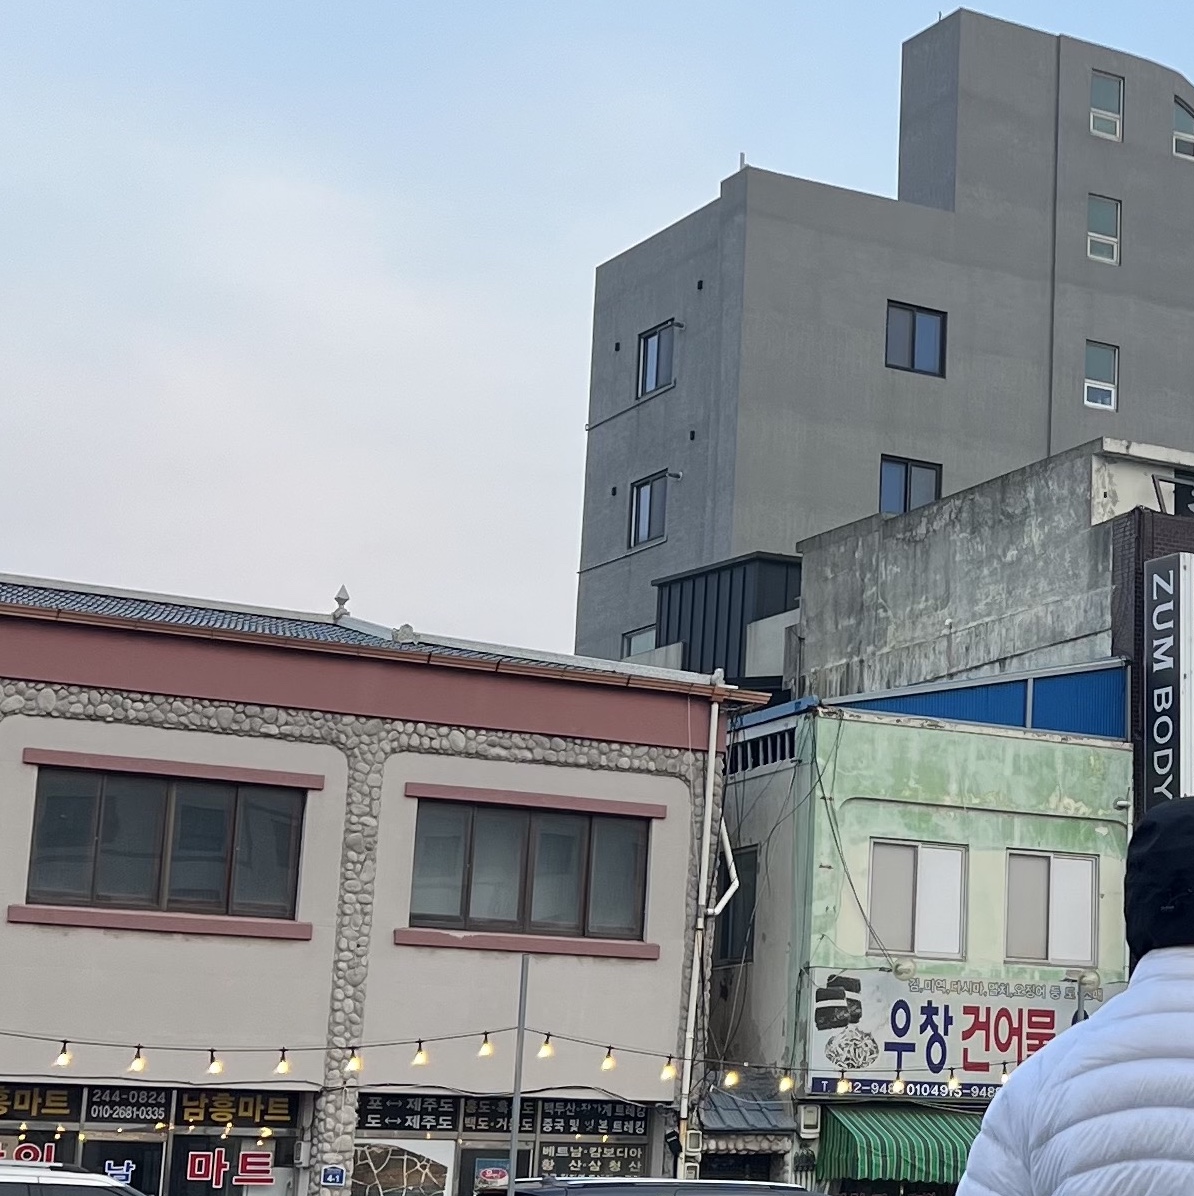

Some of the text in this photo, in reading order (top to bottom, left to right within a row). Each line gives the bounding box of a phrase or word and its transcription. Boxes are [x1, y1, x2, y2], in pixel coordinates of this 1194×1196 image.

[1152, 570, 1174, 801] ZUM BODY
[884, 999, 953, 1074] 우창
[92, 1089, 166, 1104] 244-0824
[182, 1092, 292, 1123] 남흥마트
[406, 1097, 454, 1112] 제주도
[90, 1105, 165, 1120] 010-2681-0335
[404, 1115, 453, 1129] 제주도
[612, 1120, 645, 1134] 트레킹
[187, 1147, 275, 1189] 마트
